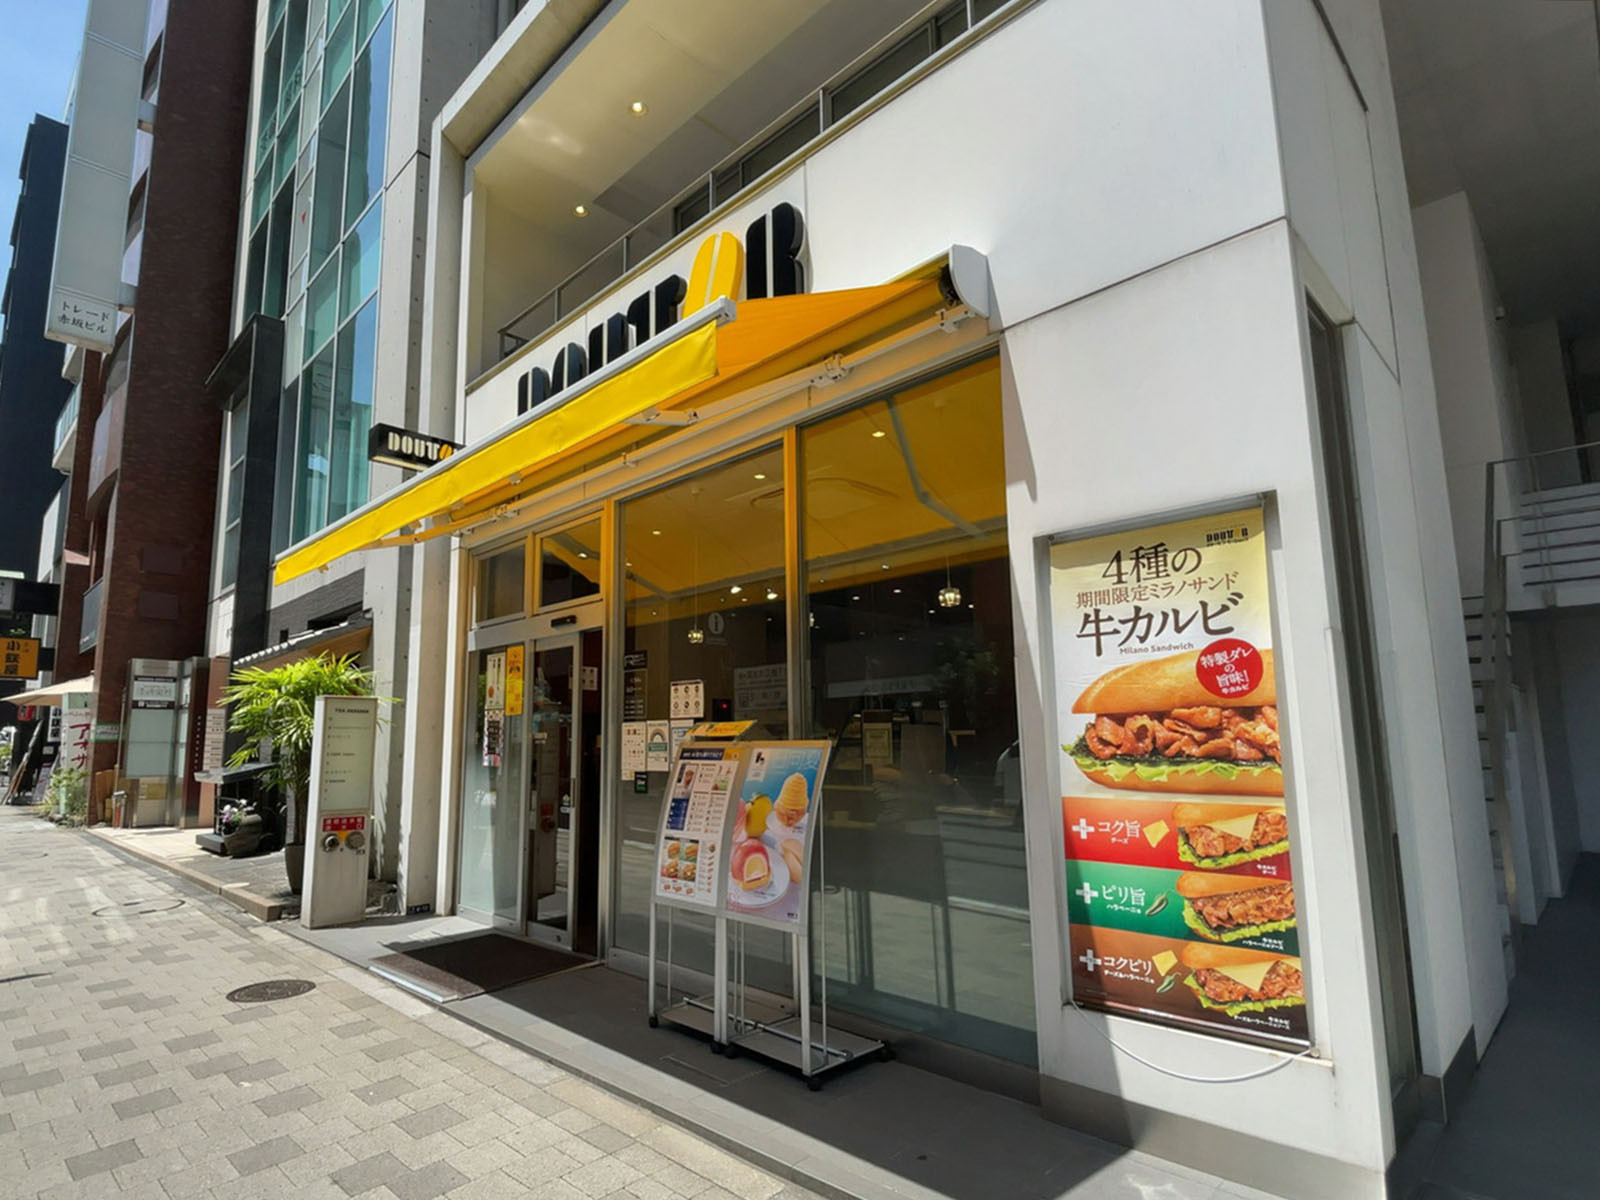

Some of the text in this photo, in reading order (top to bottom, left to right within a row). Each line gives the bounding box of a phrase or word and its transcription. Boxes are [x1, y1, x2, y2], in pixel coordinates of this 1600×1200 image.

[62, 301, 110, 321] トレード
[58, 313, 107, 333] 赤坂ビル
[388, 431, 458, 461] DOUTO
[1102, 542, 1202, 585] 4種の
[1076, 571, 1239, 609] 期間限定ミラノサンド
[1076, 592, 1244, 657] 牛カルビ
[1120, 642, 1194, 654] Milano Sandwich
[1200, 646, 1254, 668] 特製ダレ
[1224, 663, 1236, 673] の
